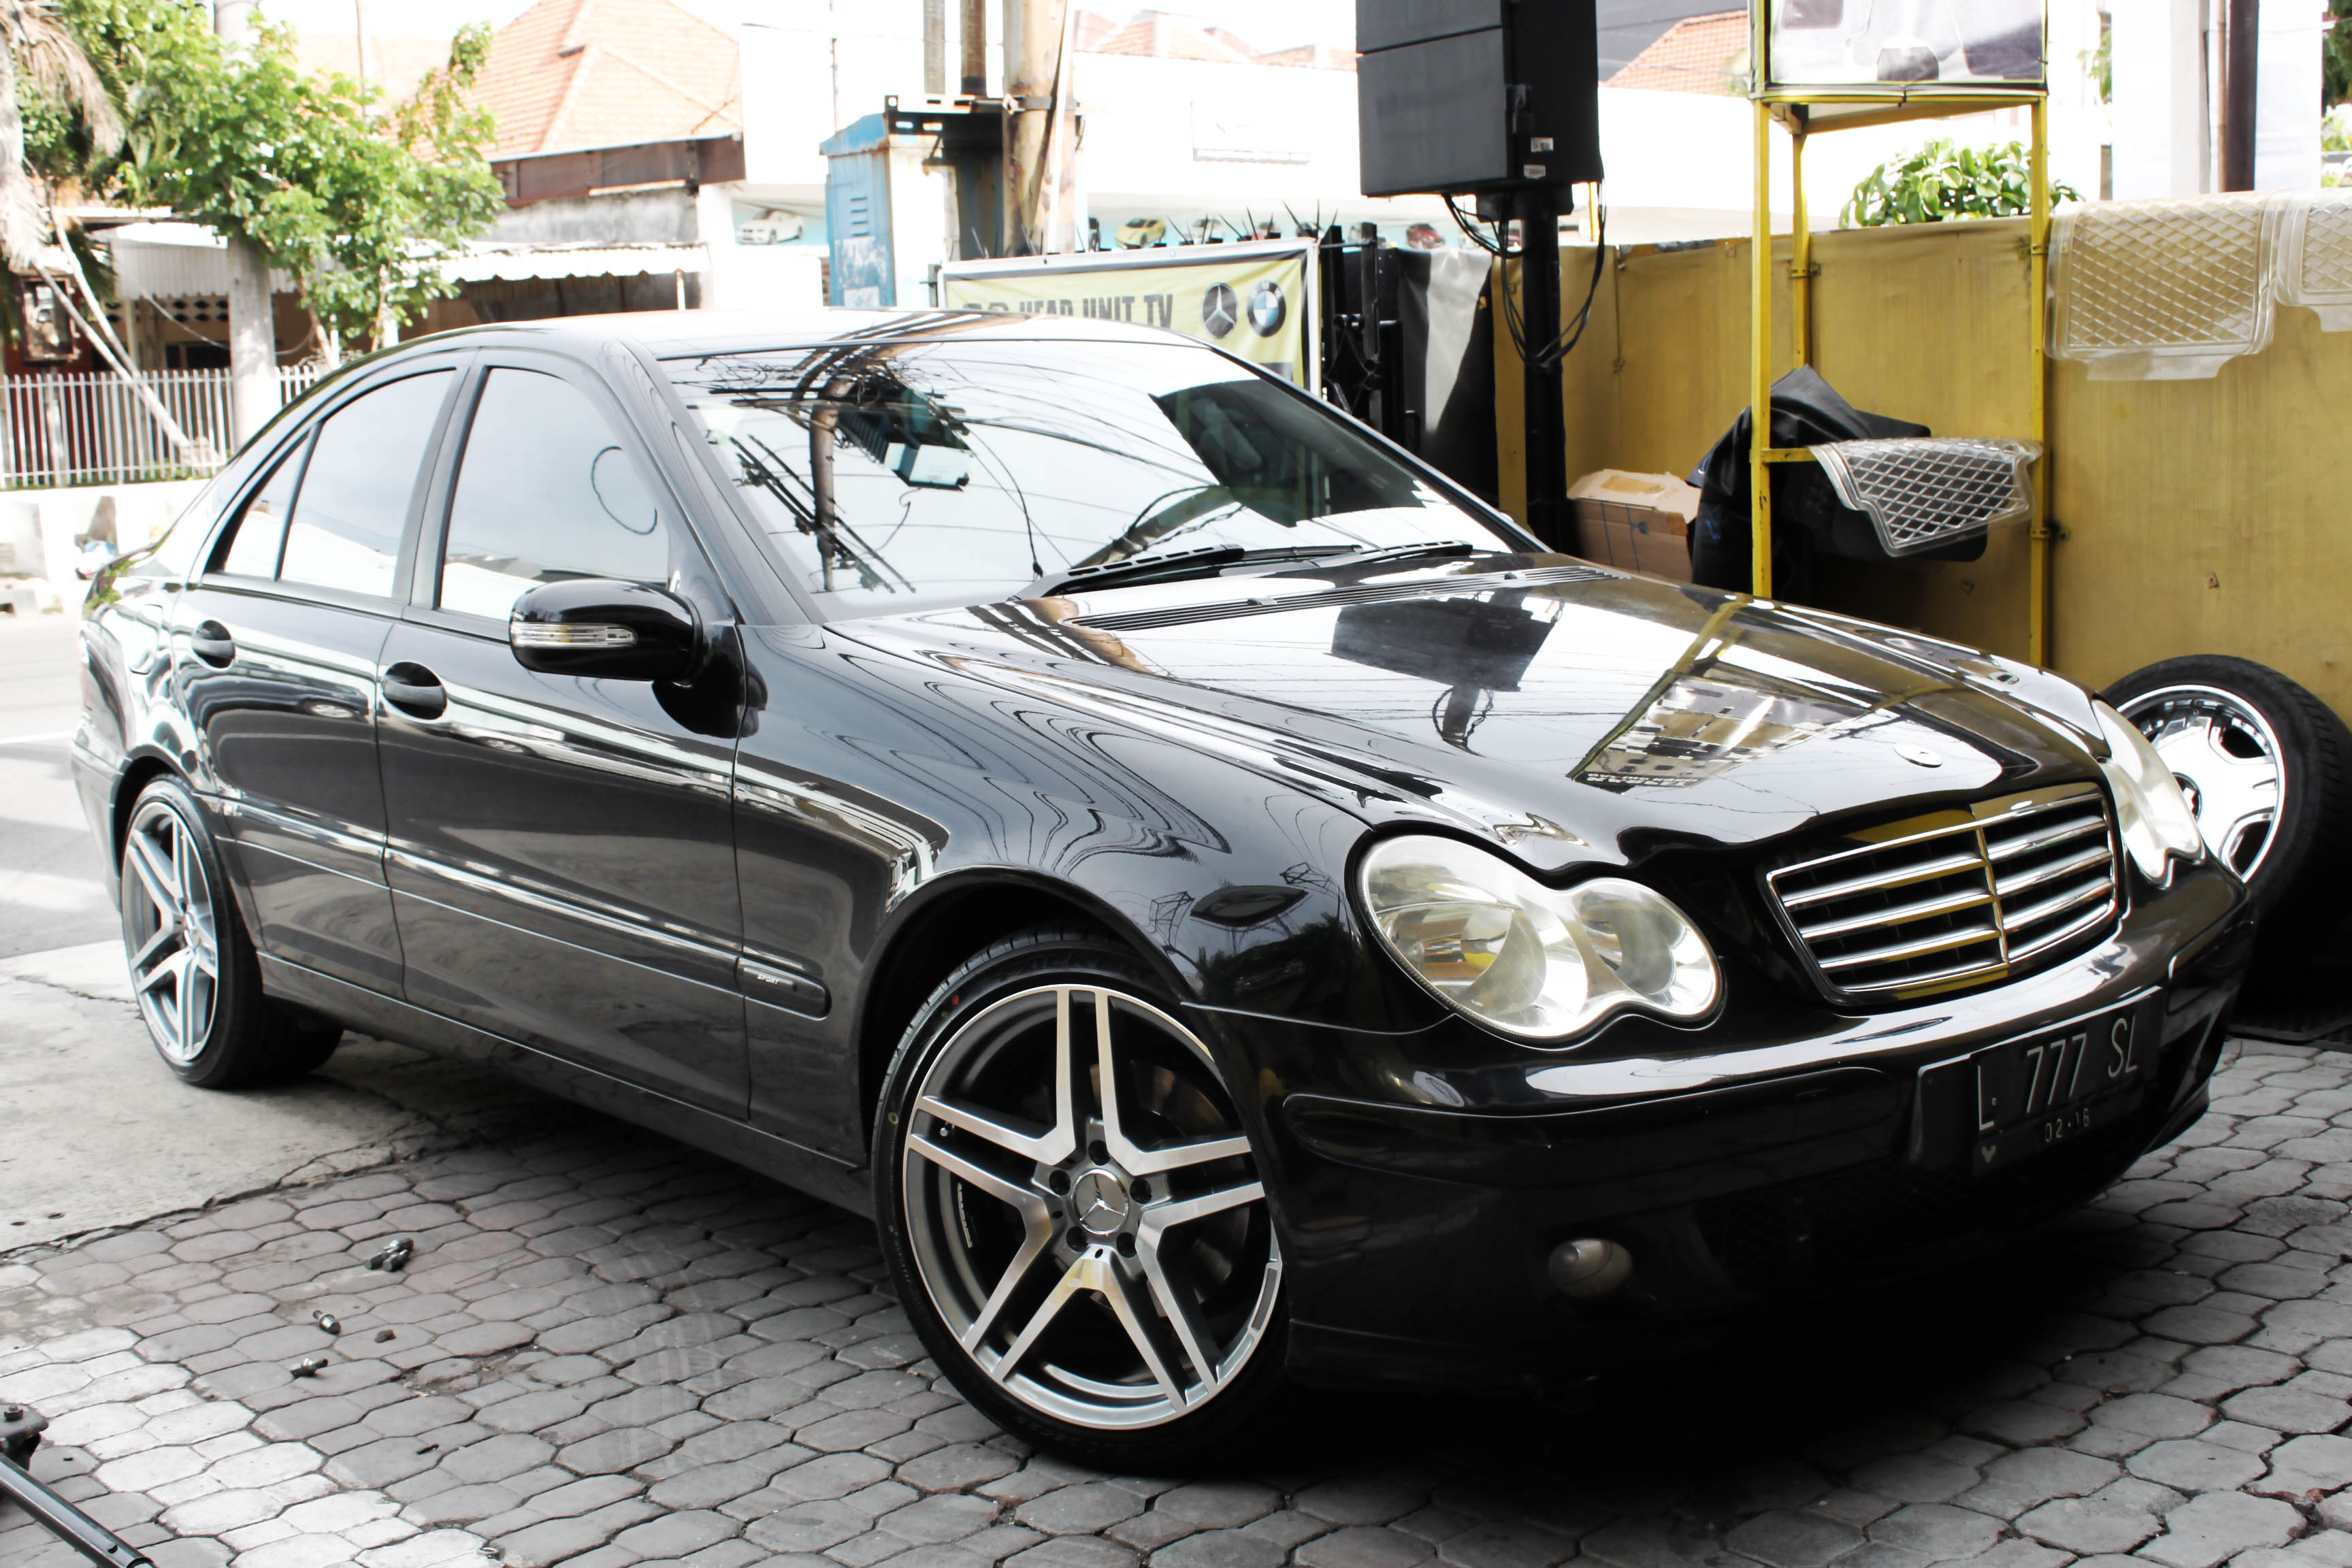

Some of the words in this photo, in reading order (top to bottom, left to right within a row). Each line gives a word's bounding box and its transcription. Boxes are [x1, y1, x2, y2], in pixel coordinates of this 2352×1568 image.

[1143, 294, 1173, 329] TV
[1977, 1064, 1995, 1131] L
[2026, 1032, 2087, 1114] 777
[2107, 1014, 2139, 1079] SL
